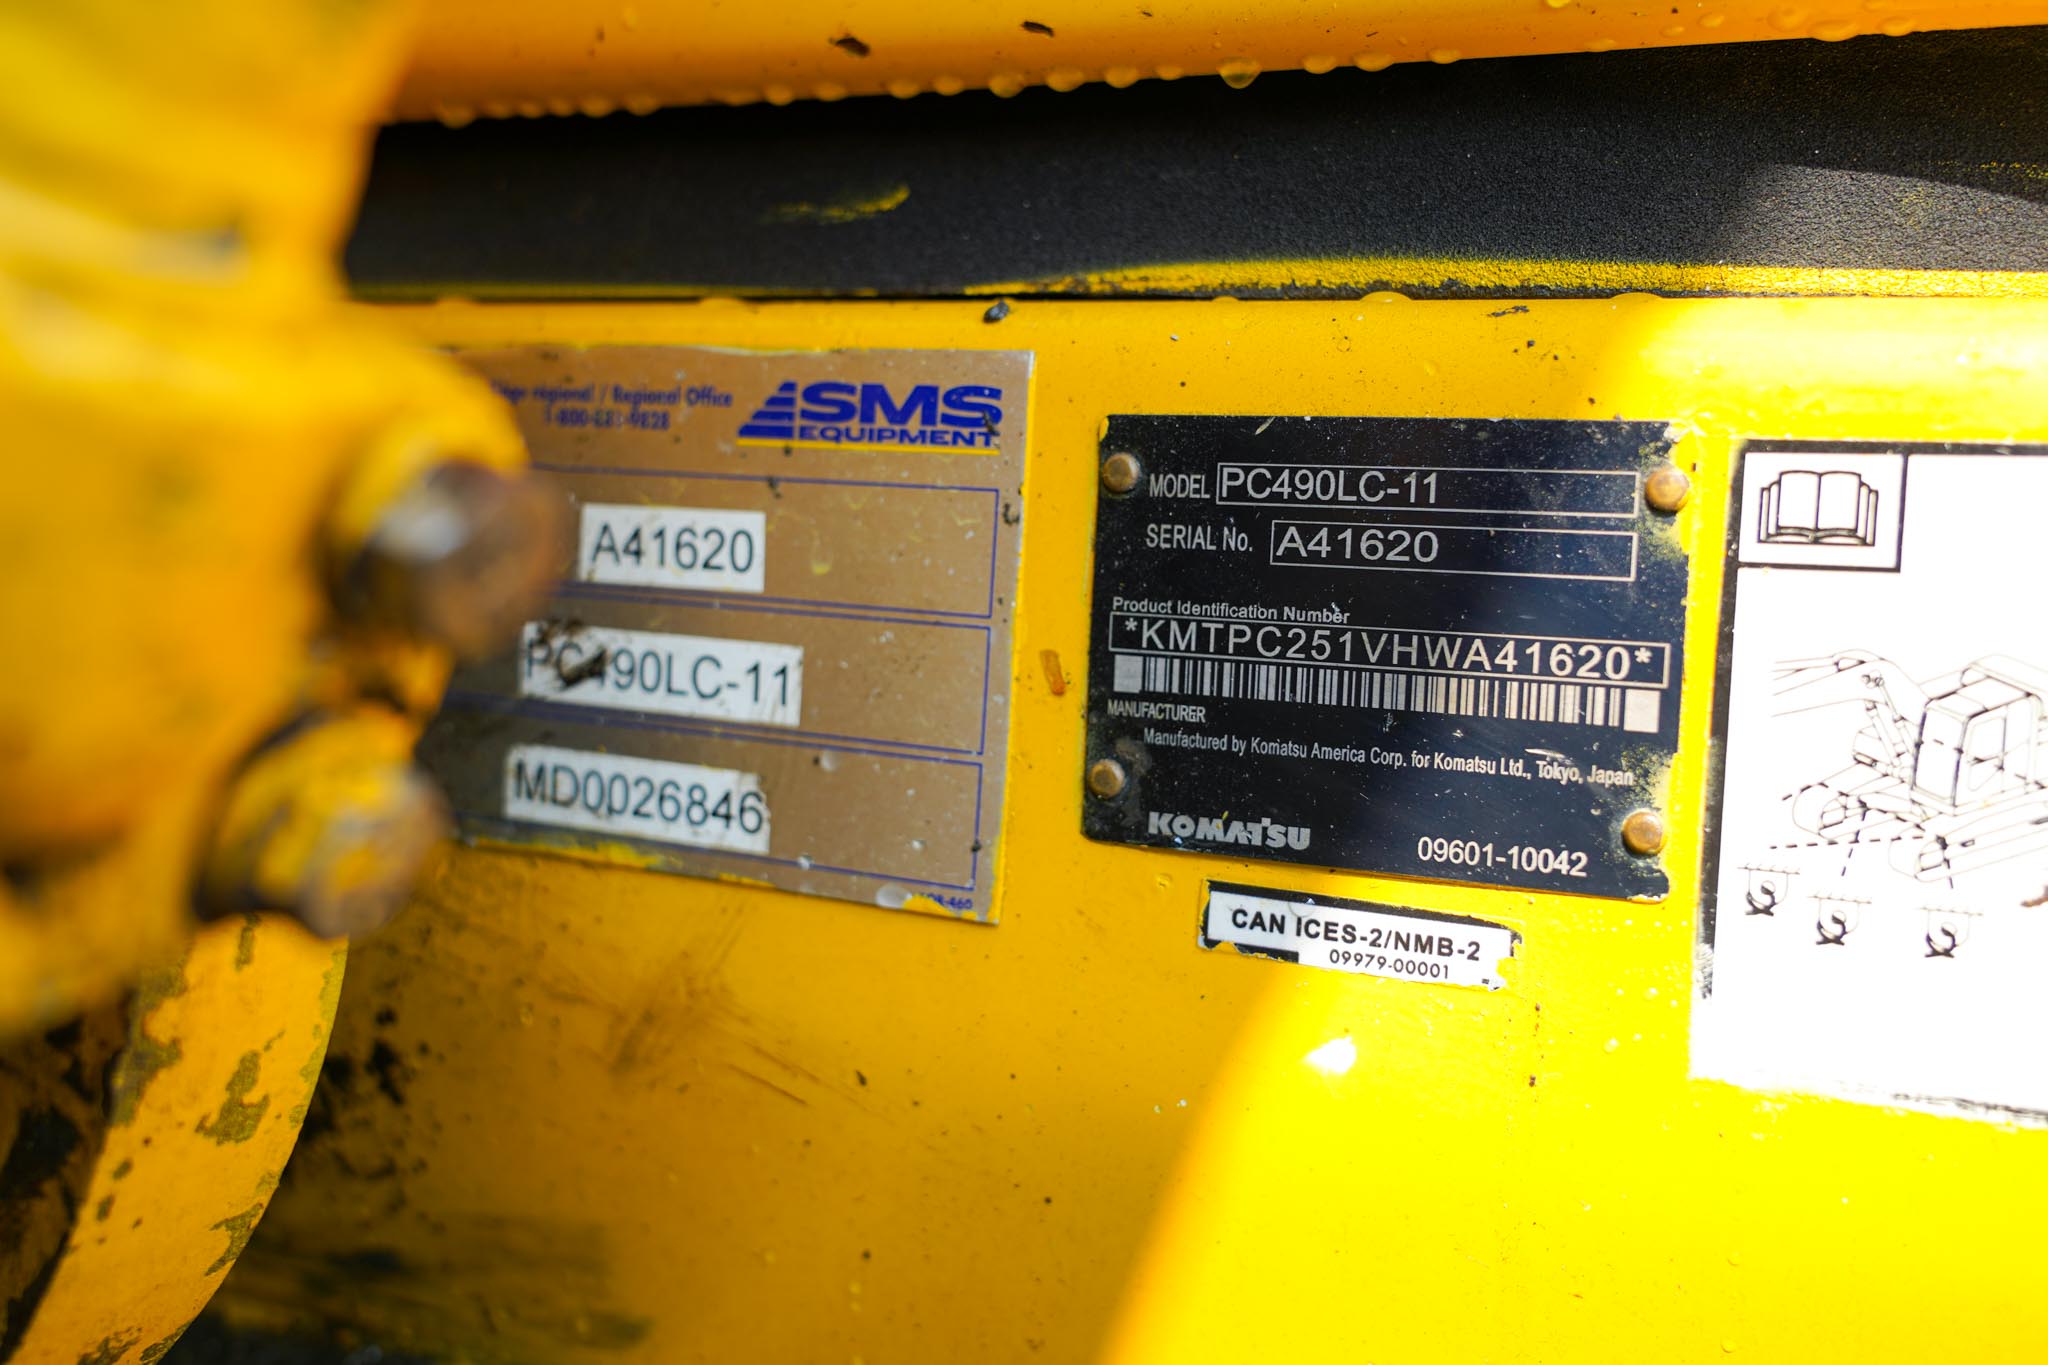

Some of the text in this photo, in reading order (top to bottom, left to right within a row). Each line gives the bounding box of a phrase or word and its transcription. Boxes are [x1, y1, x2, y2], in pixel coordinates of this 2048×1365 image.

[612, 385, 682, 408] Regional
[685, 386, 733, 408] Office
[799, 381, 1003, 428] SMS
[799, 425, 1000, 447] EQUIPMENT
[1149, 467, 1438, 504] MODEL PC490LC-11
[591, 522, 755, 573] A41620
[1146, 523, 1439, 563] SERIAL No. A41620
[1113, 597, 1351, 625] Product Identification Number
[1107, 699, 1206, 723] MANUFACTURER
[1144, 728, 1634, 788] Manufactured by Komatsu America Corp. for Komatsu Ltd., Tokyo, Japan
[513, 758, 765, 834] MD0026846
[1148, 811, 1310, 850] KOMATSU
[1417, 836, 1588, 877] 09601-10042
[1232, 907, 1481, 961] CAN ICES-2/NMB-2
[1329, 949, 1450, 979] 09979-00001
